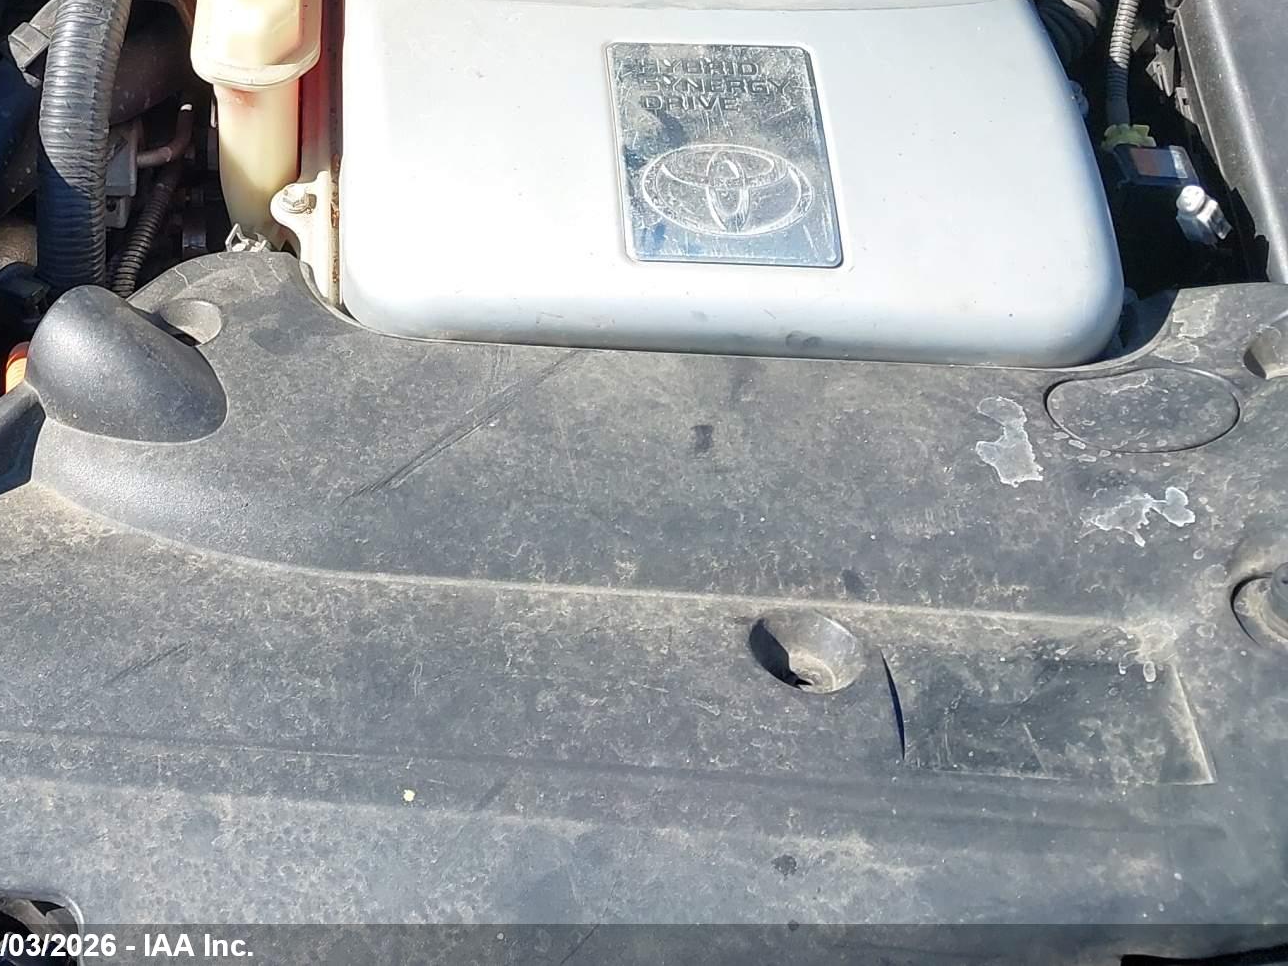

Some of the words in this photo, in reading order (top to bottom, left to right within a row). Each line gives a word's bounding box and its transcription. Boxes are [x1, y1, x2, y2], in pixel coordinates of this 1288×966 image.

[638, 57, 759, 76] HYBRID
[639, 76, 793, 96] SYNERGY
[641, 94, 743, 113] DRIVE
